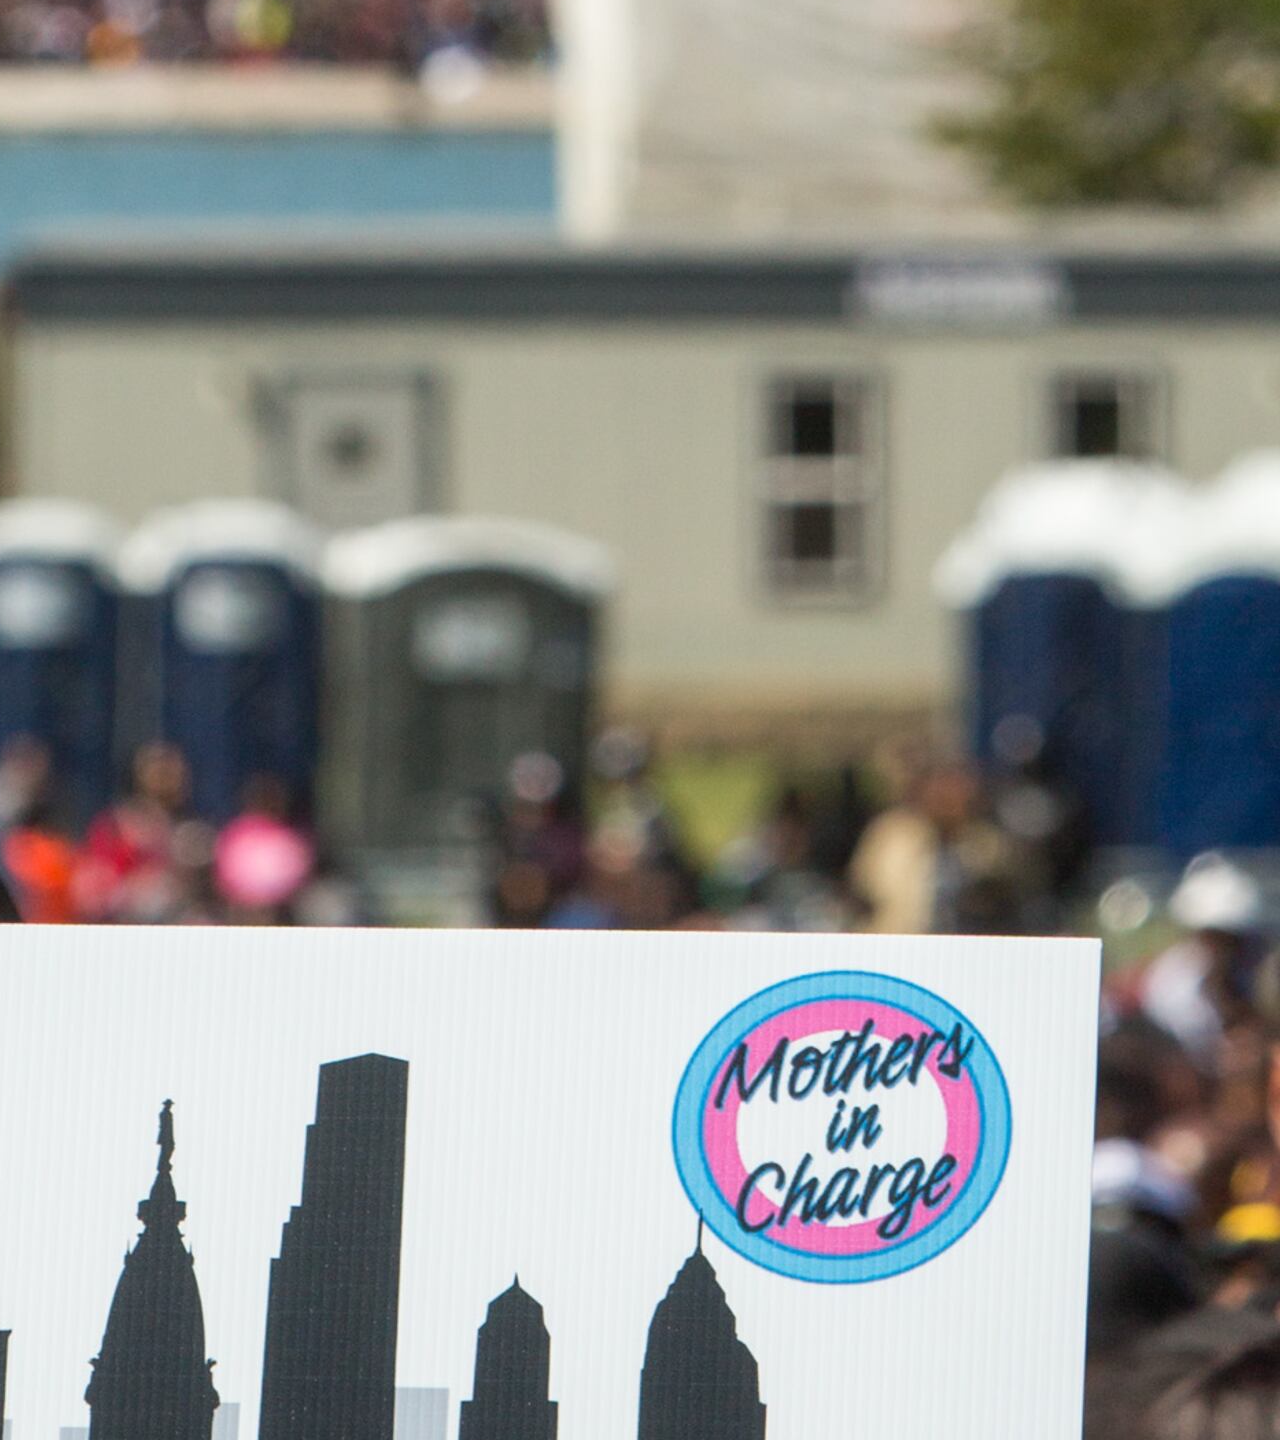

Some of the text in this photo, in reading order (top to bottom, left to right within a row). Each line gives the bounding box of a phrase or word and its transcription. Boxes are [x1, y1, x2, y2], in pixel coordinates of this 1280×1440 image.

[714, 1018, 973, 1110] Mothers
[825, 1099, 882, 1152] in
[736, 1153, 957, 1239] Charge
